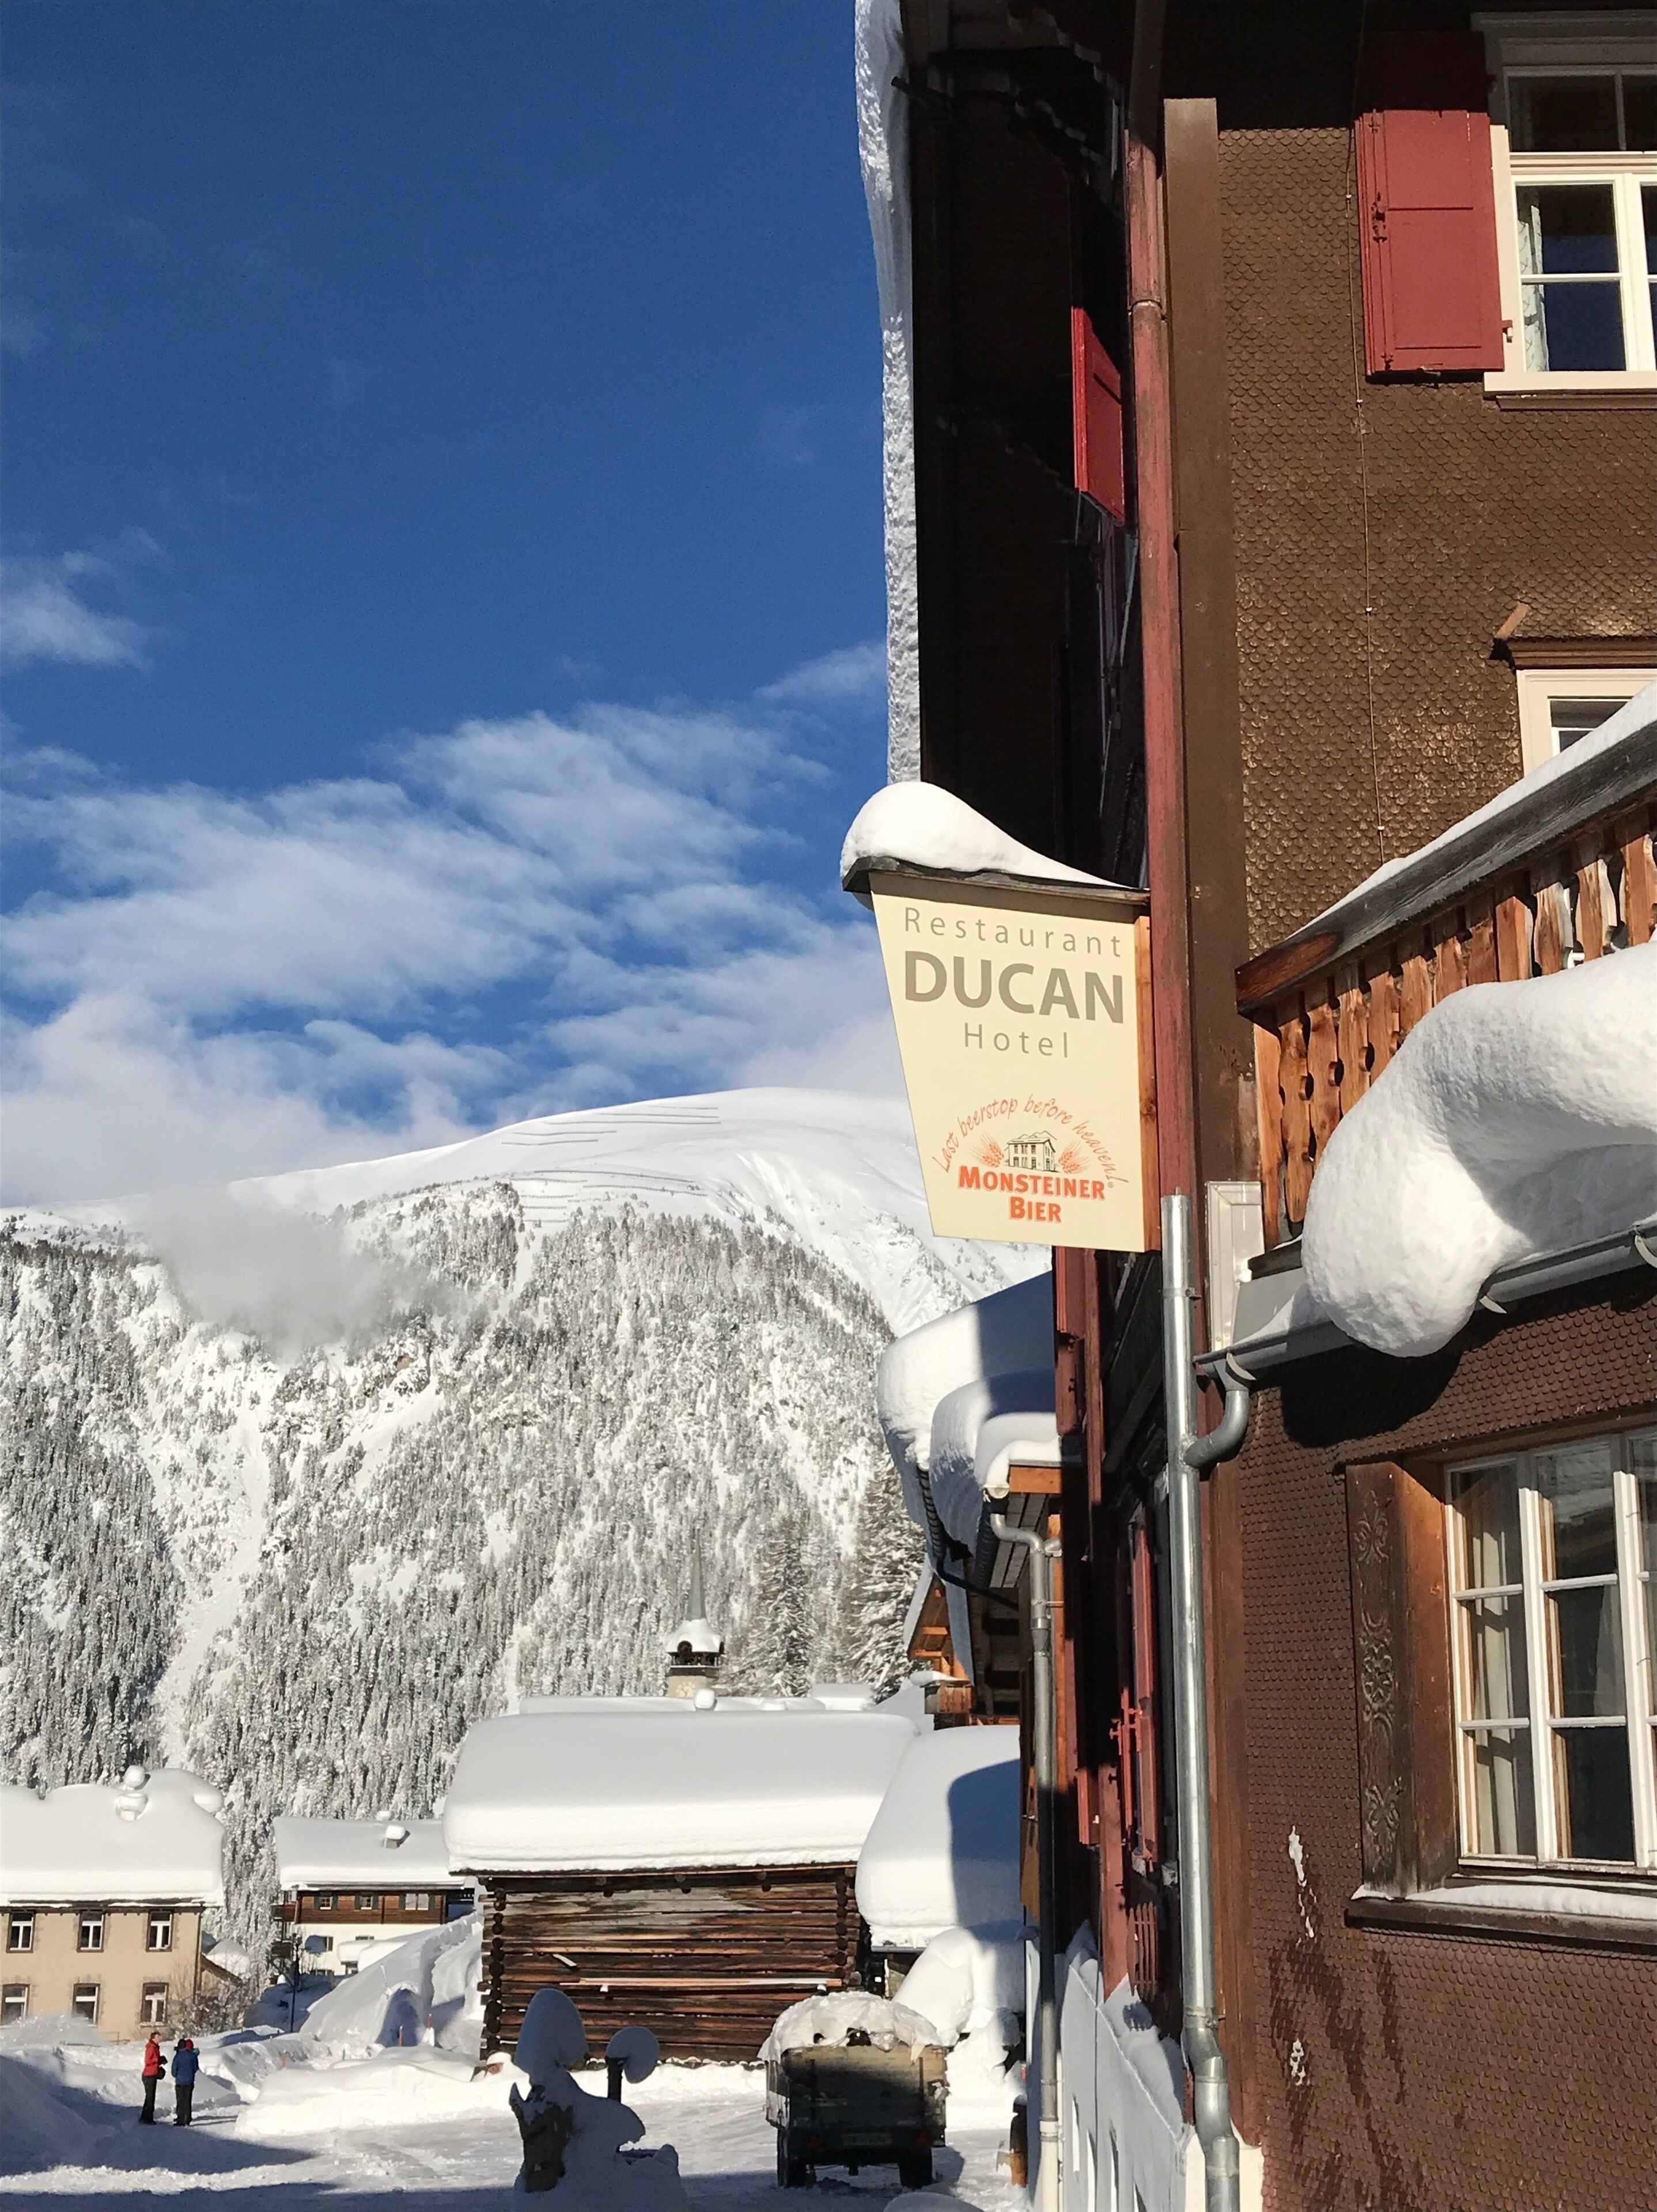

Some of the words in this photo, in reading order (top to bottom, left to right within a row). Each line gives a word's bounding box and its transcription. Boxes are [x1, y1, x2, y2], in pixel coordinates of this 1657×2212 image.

[905, 907, 1121, 957] Restaurant
[905, 950, 1124, 1024] DUCAN
[964, 1022, 1068, 1058] Hotel
[932, 1131, 959, 1173] Last
[956, 1097, 1018, 1138] beerstop
[1023, 1093, 1073, 1124] before
[1072, 1120, 1129, 1183] heaven!
[958, 1165, 1106, 1200] MONSTEINER
[1008, 1196, 1062, 1223] BIER
